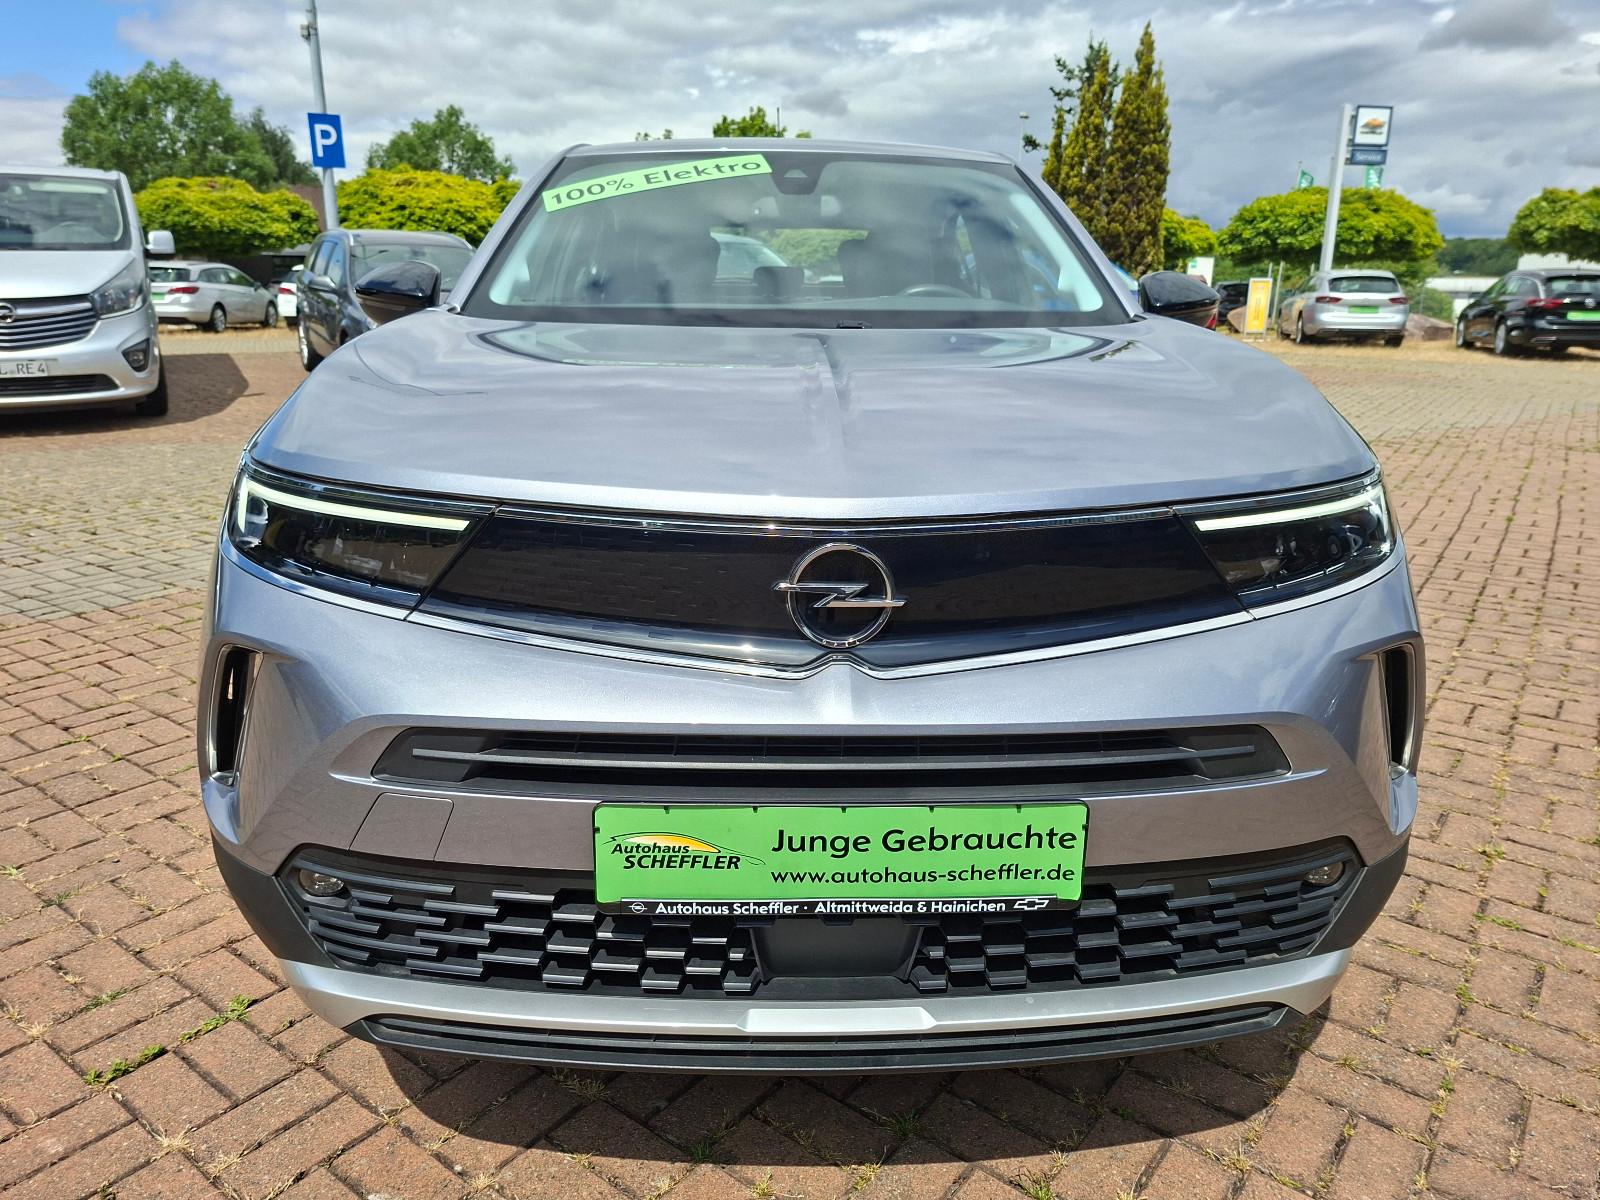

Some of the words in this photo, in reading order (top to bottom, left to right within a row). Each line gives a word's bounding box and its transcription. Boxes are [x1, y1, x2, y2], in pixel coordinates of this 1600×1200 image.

[314, 123, 337, 158] P
[551, 177, 634, 204] 100%
[644, 161, 761, 185] Elektro
[611, 842, 690, 855] Autohaus
[771, 829, 872, 858] Junge
[881, 825, 1078, 853] Gebrauchte
[623, 854, 741, 870] SCHEFFLER
[771, 864, 1075, 884] www.autohaus-scheffler.de
[655, 902, 730, 915] Autohaus
[733, 902, 799, 915] Scheffler
[814, 900, 914, 914] Altmittweida
[917, 901, 927, 913] &
[931, 899, 1006, 913] Hainichen
